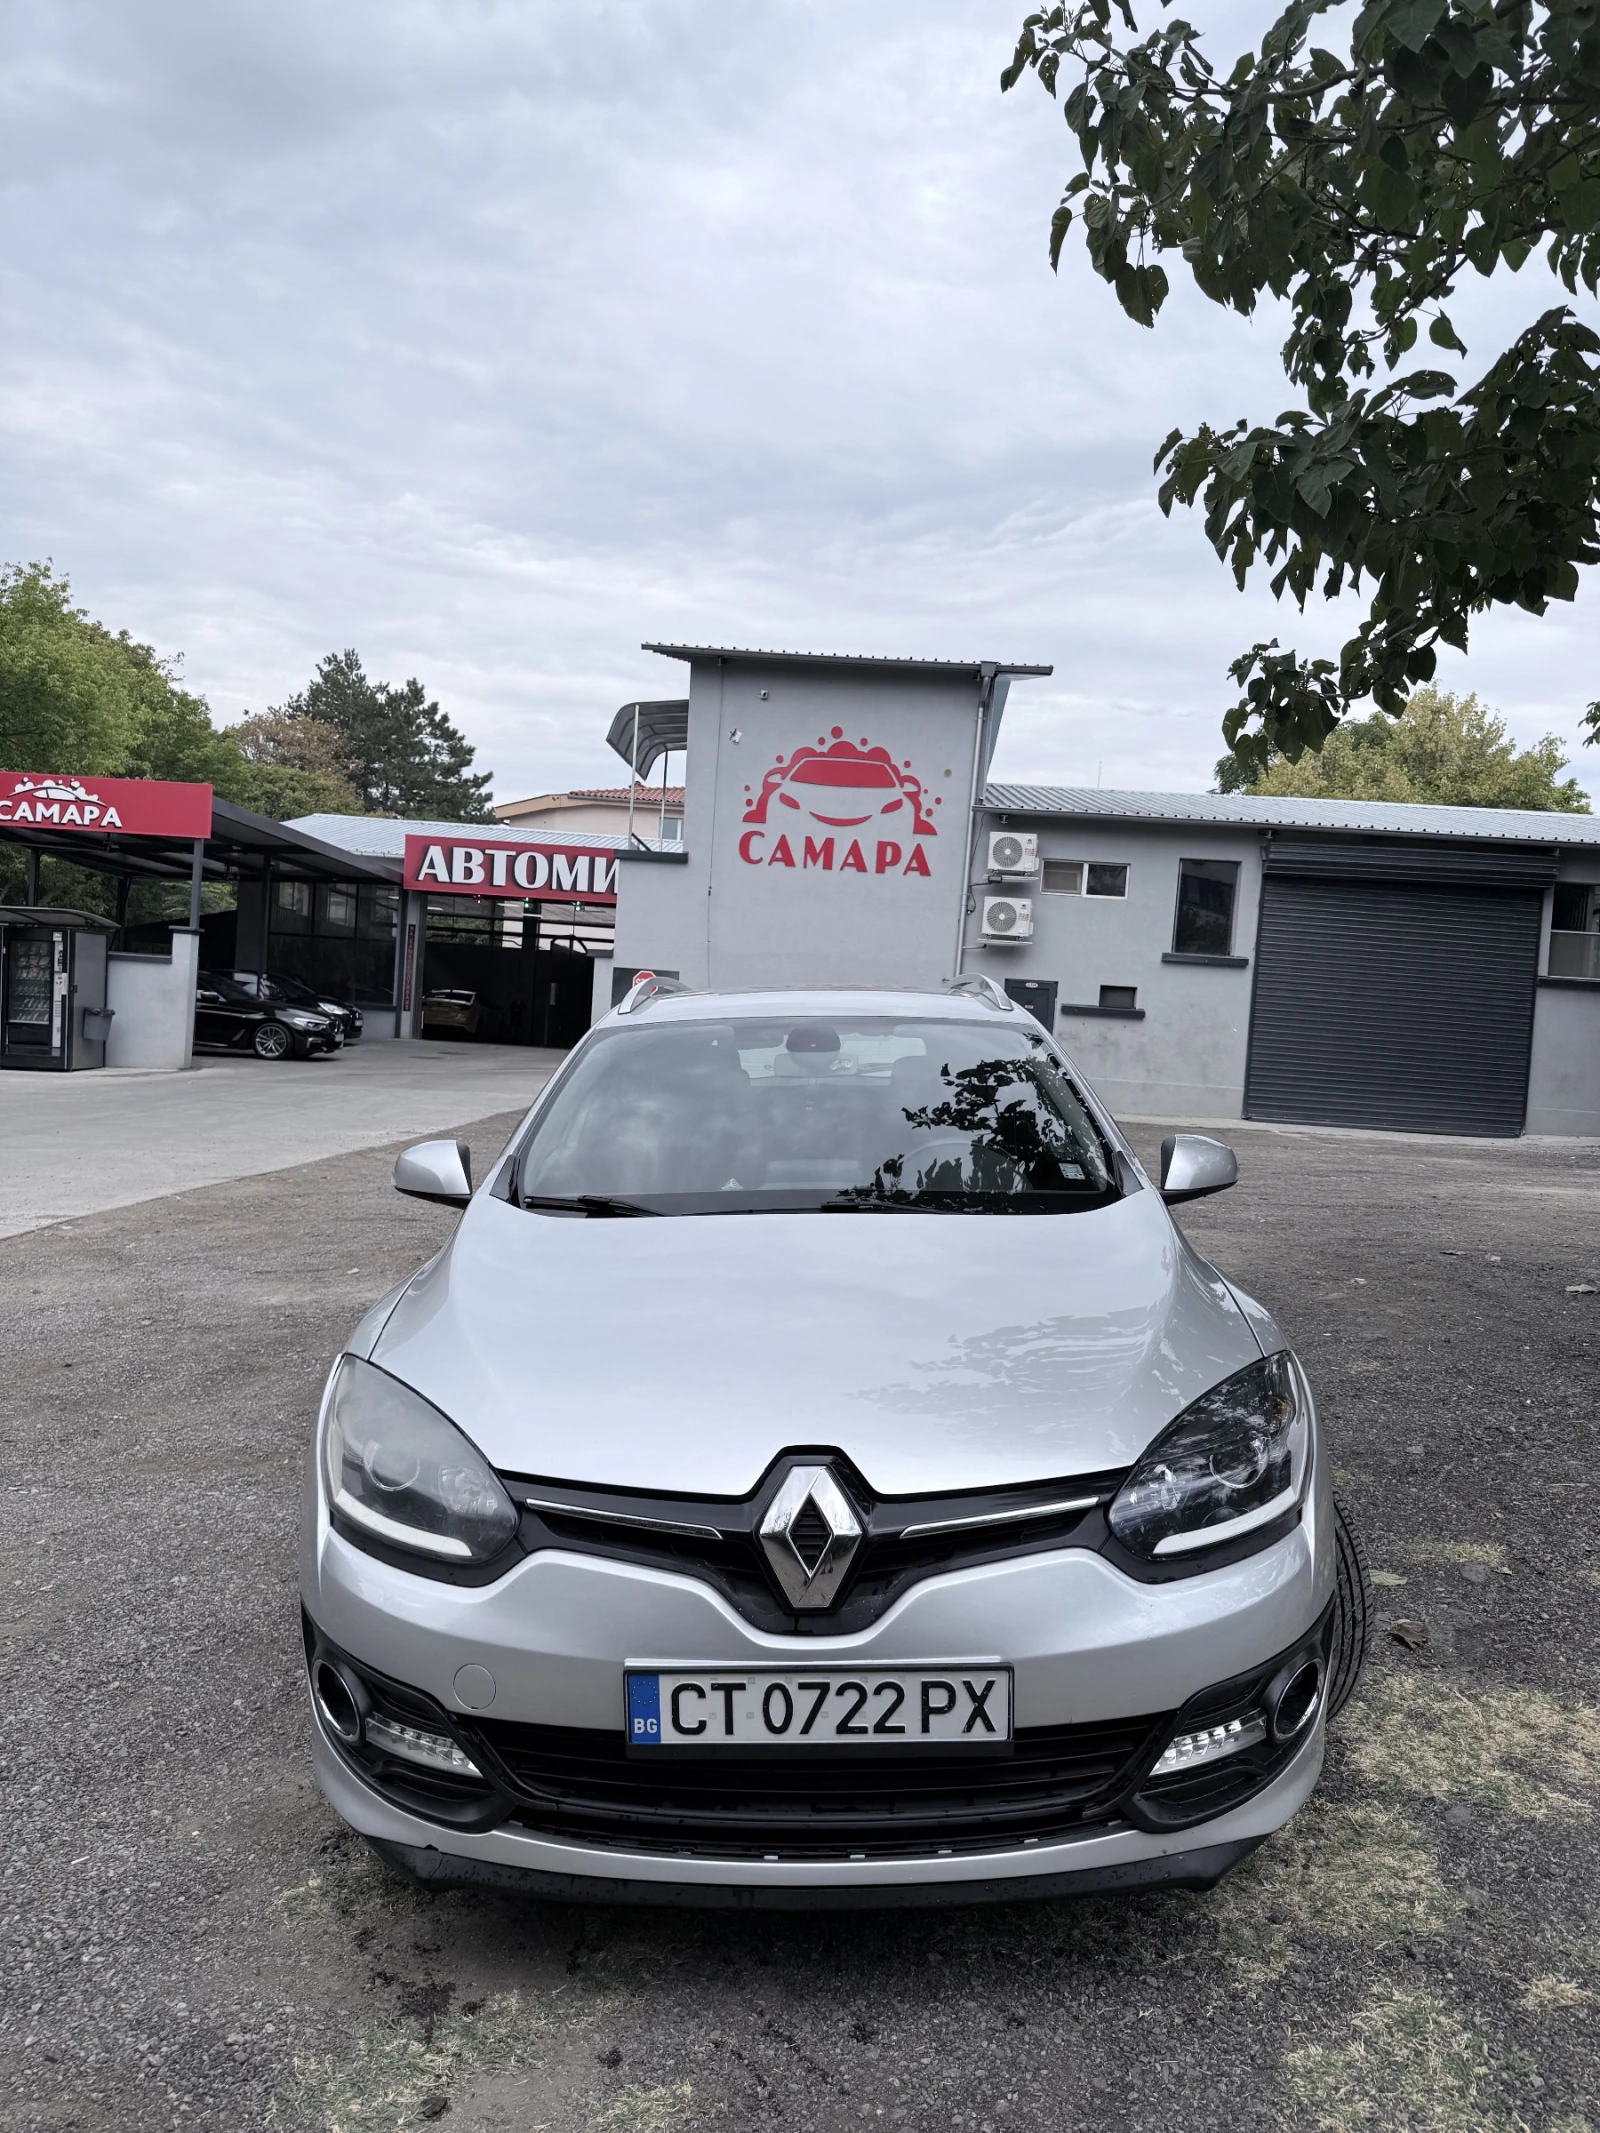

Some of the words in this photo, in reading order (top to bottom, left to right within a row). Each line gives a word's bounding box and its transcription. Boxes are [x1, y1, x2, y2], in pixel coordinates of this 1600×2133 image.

[0, 800, 123, 828] САМАРА
[417, 845, 620, 894] АВТОМИ
[738, 830, 932, 877] САМАРА
[633, 1717, 658, 1735] BG
[670, 1681, 747, 1736] CT
[762, 1680, 906, 1735] 0722
[920, 1680, 997, 1734] PX
